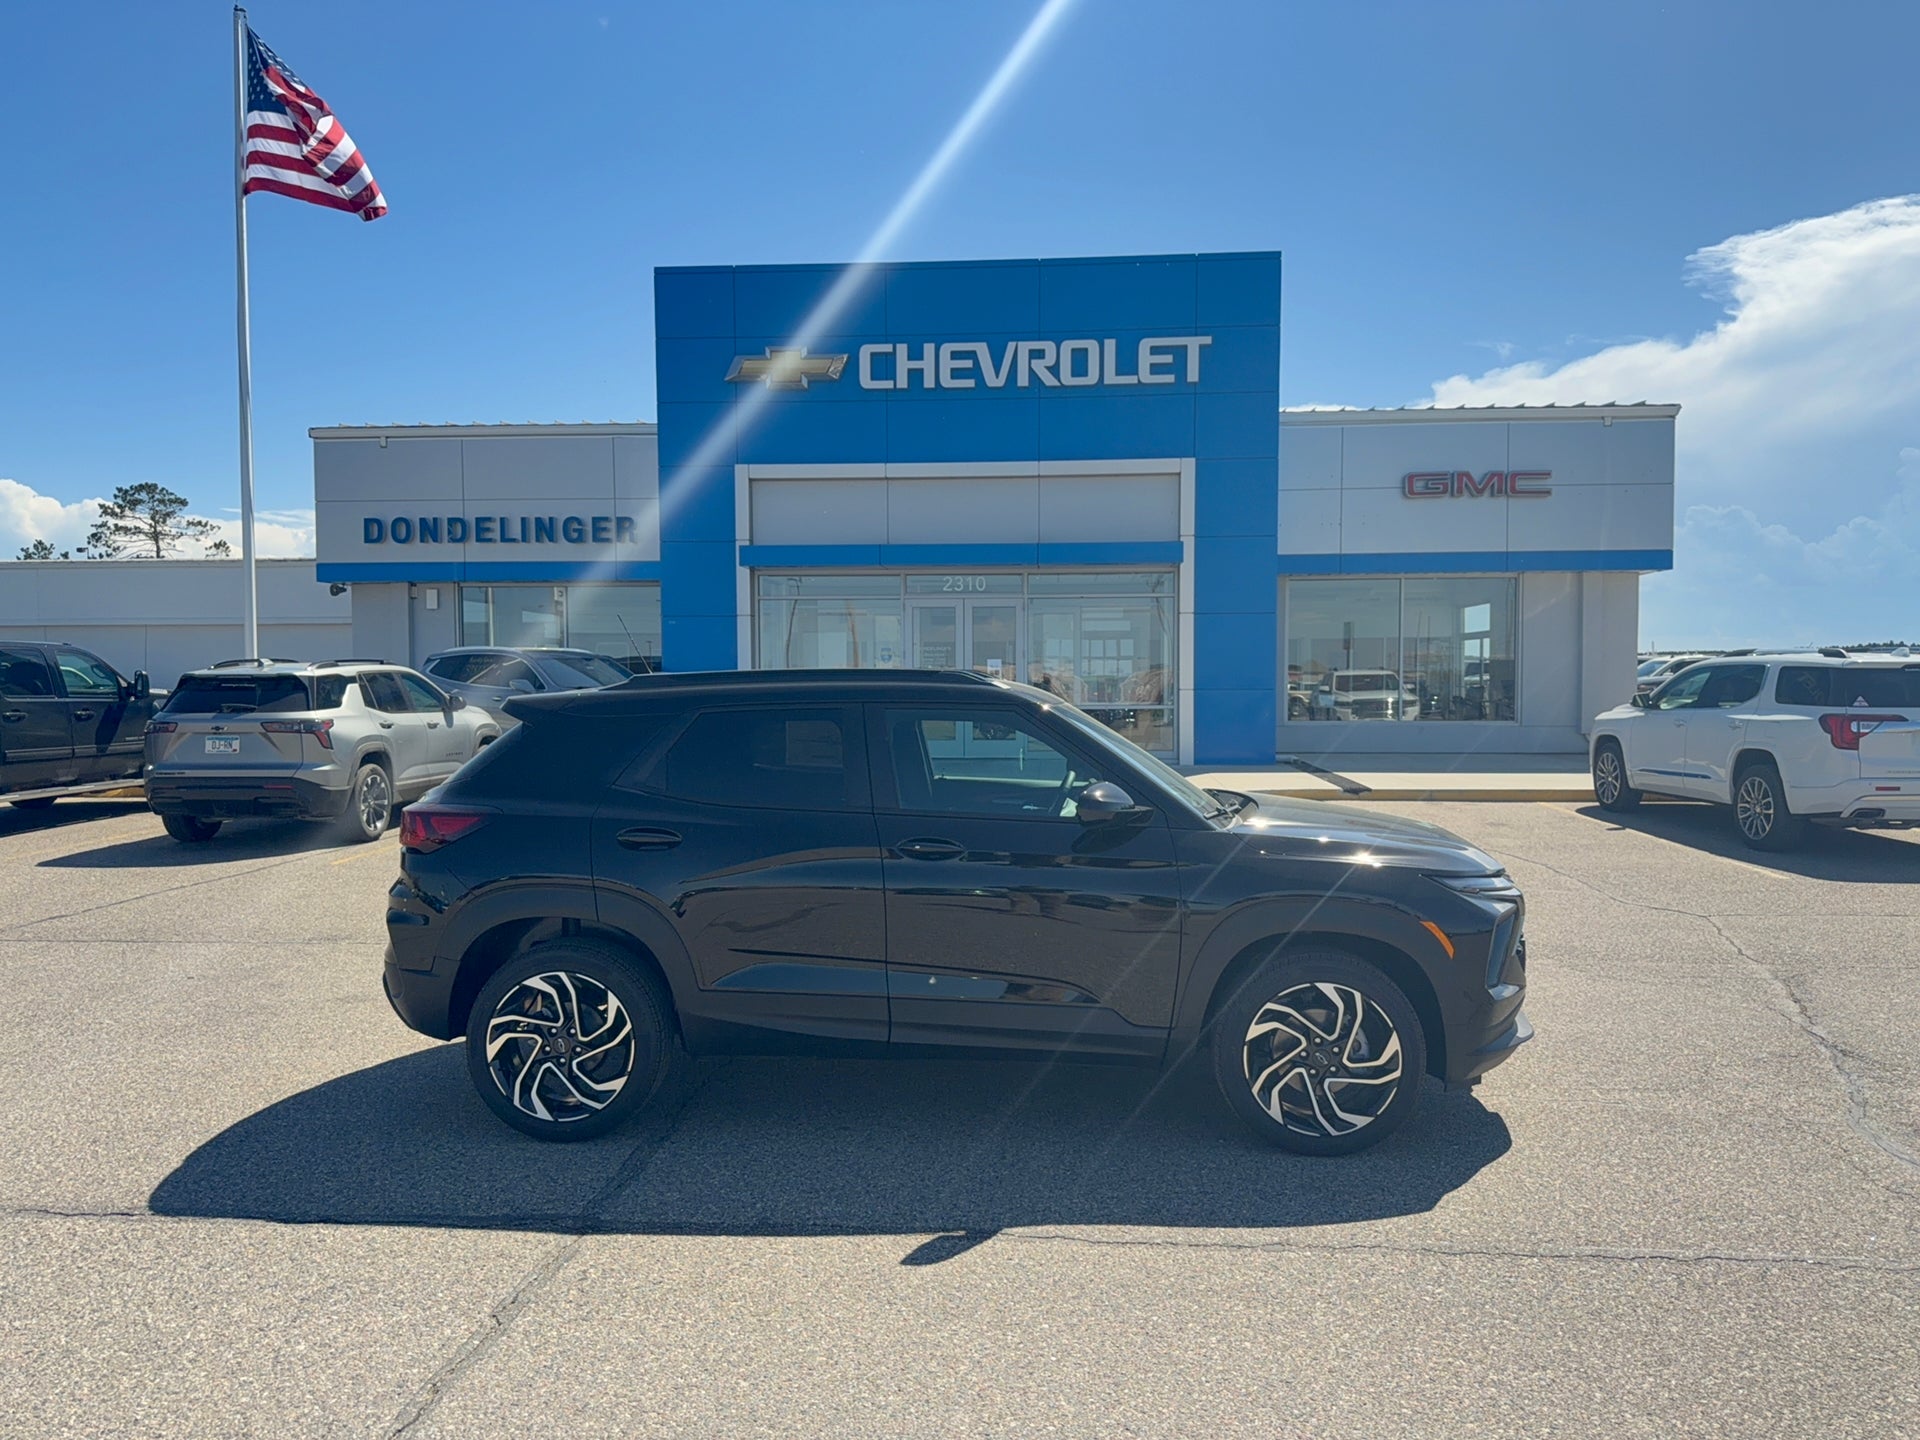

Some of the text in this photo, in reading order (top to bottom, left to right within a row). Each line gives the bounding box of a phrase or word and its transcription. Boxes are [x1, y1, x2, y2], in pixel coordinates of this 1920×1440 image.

[858, 335, 1212, 389] CHEVROLET
[1402, 470, 1552, 498] GMC
[362, 516, 637, 544] DONDELINGER
[942, 576, 986, 591] 2310
